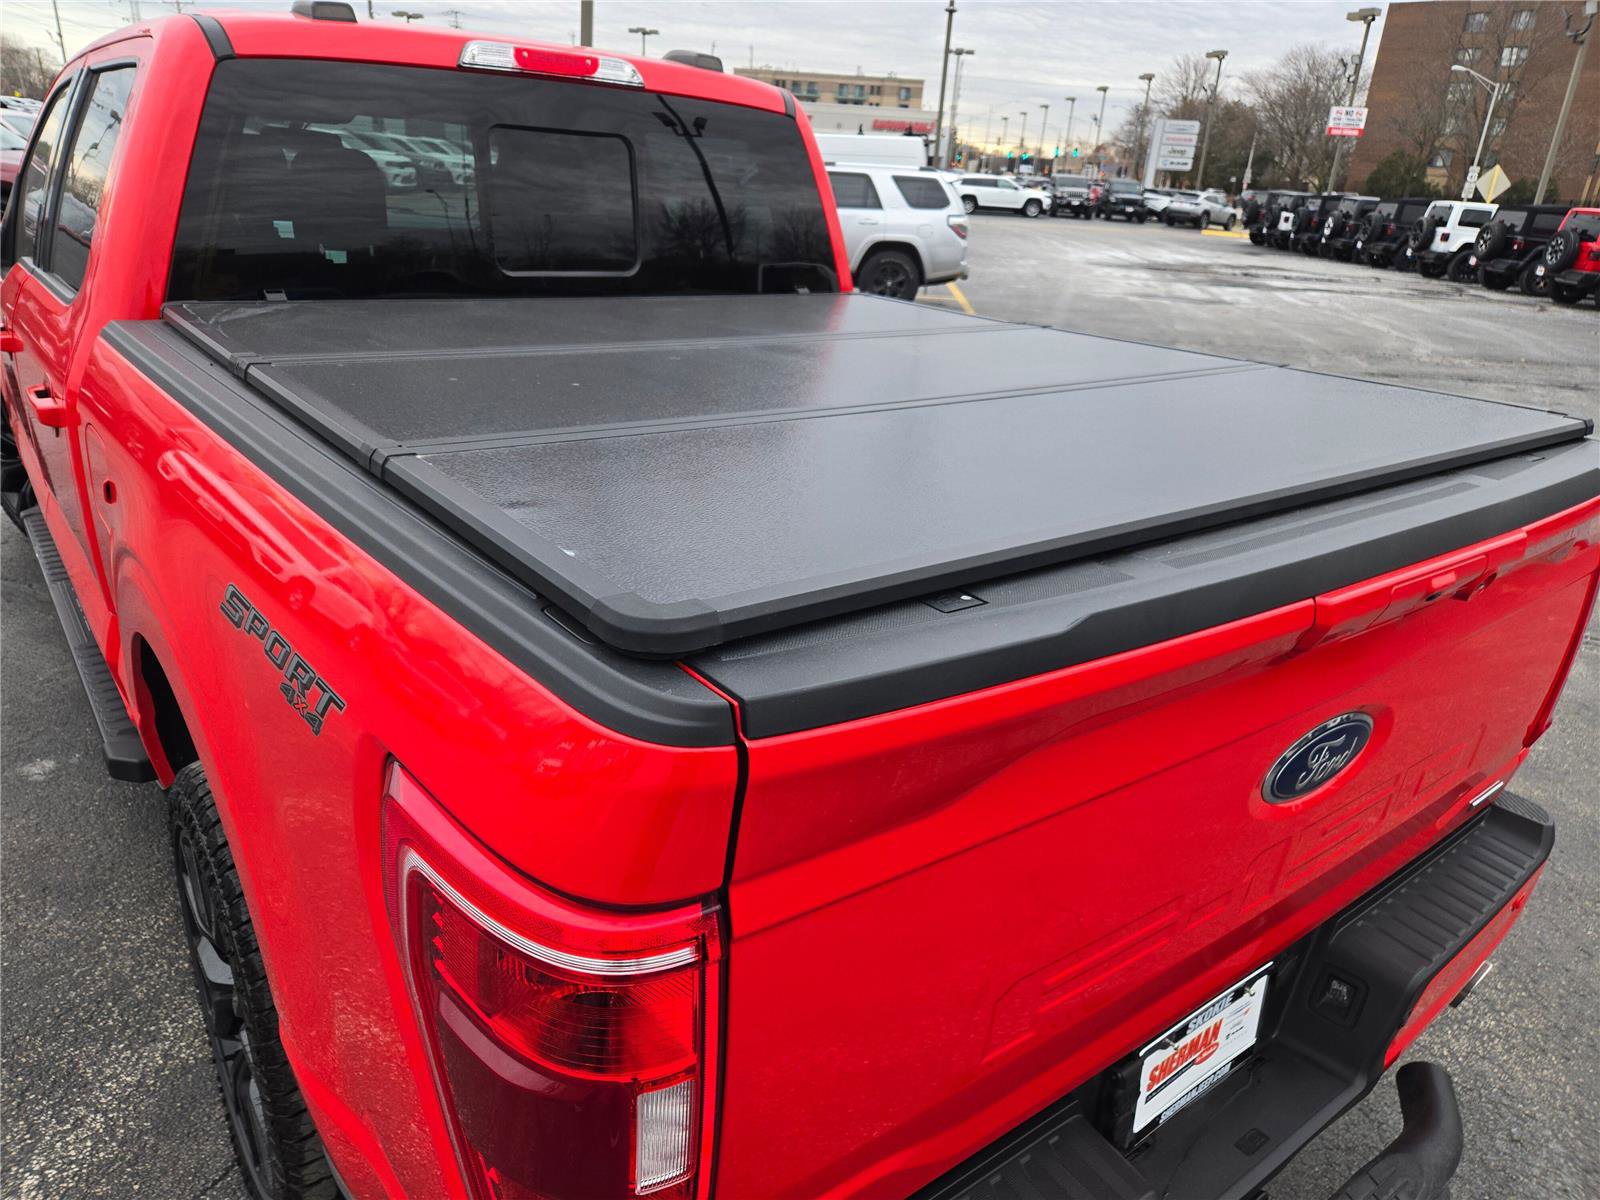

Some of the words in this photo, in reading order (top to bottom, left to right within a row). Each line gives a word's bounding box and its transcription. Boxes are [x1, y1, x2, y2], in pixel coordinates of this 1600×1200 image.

[219, 583, 347, 719] SPORT
[1296, 734, 1358, 790] Ford
[1186, 992, 1234, 1035] SKOKIE
[1147, 1018, 1224, 1092] SHERMAN
